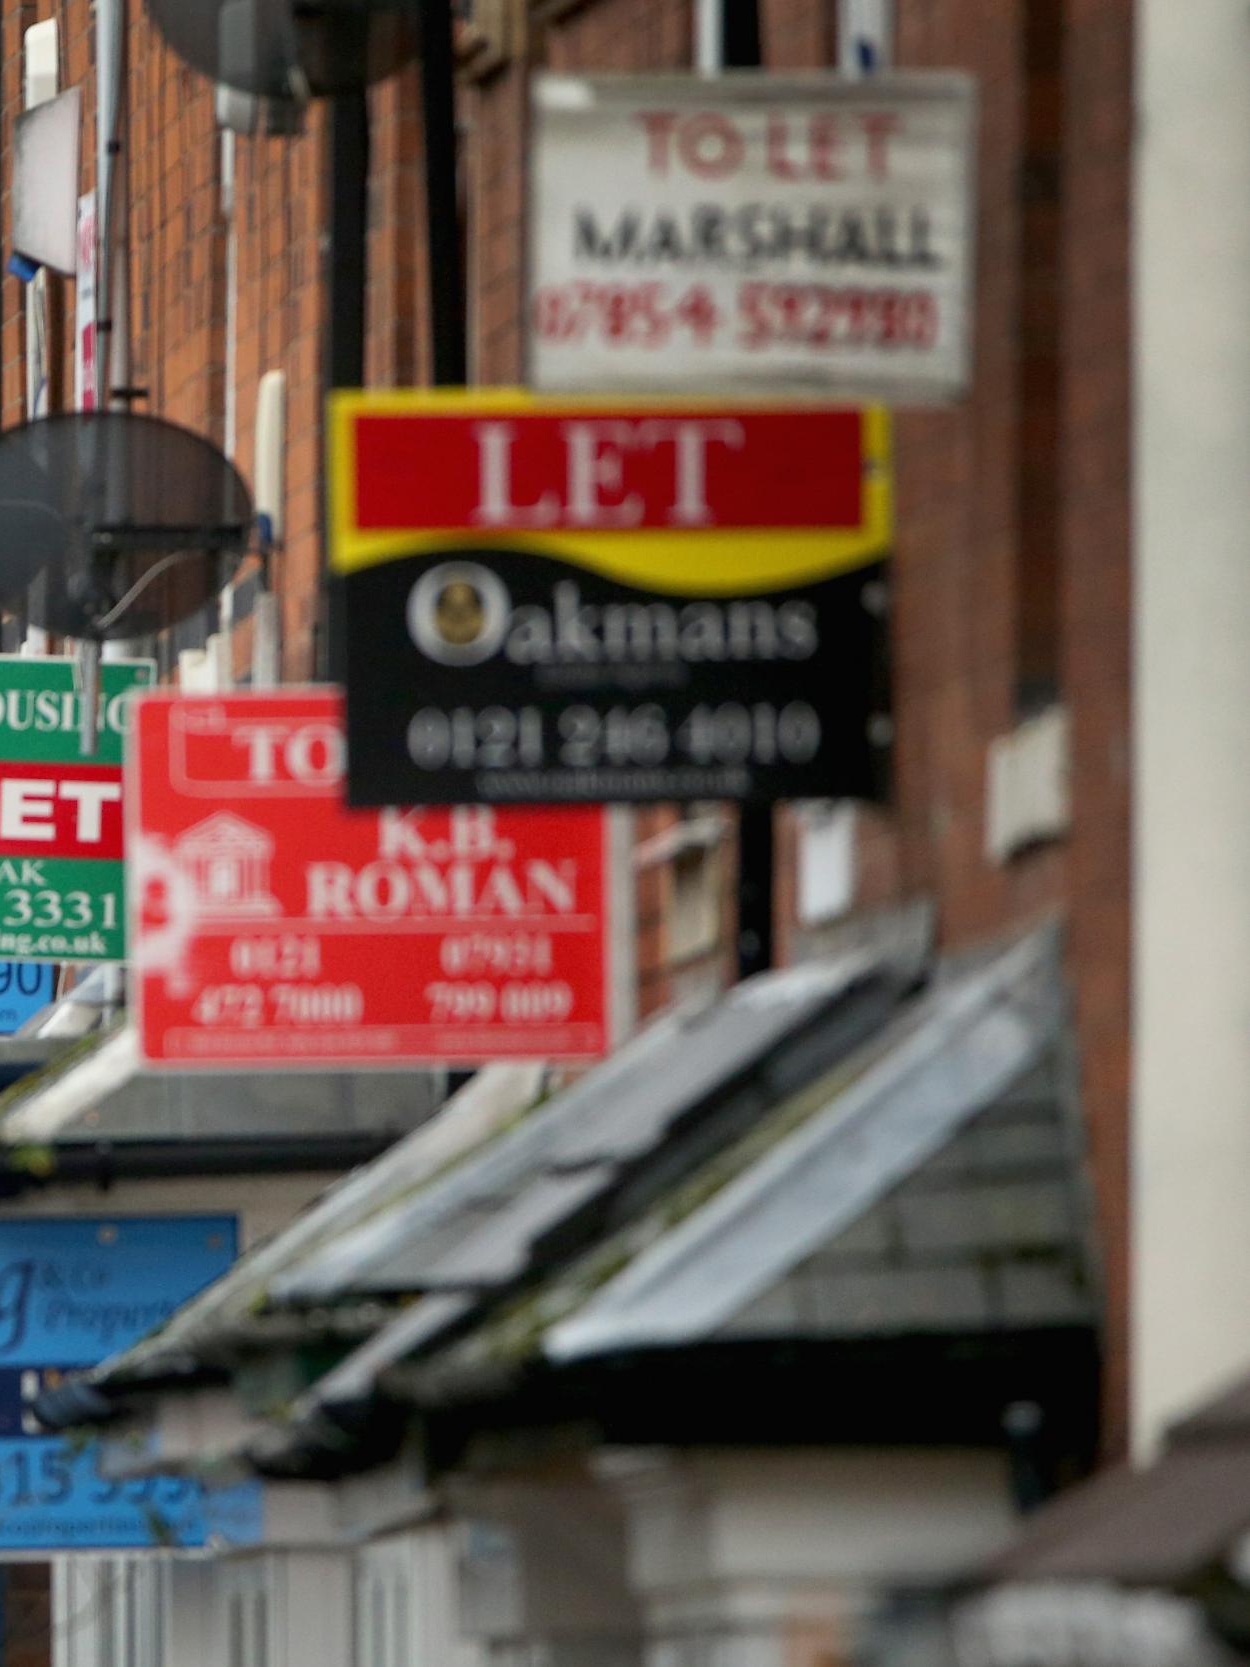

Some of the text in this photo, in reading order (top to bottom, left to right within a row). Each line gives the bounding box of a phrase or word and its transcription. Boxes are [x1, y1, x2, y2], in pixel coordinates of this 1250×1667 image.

[631, 111, 905, 183] TO LET
[574, 204, 942, 268] MARSHALL
[472, 418, 745, 529] LET
[406, 560, 818, 666] Oakmans
[233, 724, 347, 786] TO
[406, 705, 543, 770] 0121
[676, 701, 820, 764] 4010
[377, 804, 515, 859] K.B.
[4, 890, 117, 930] 3331
[306, 859, 576, 921] ROMAN
[230, 934, 321, 977] 0121
[191, 982, 265, 1027] 472
